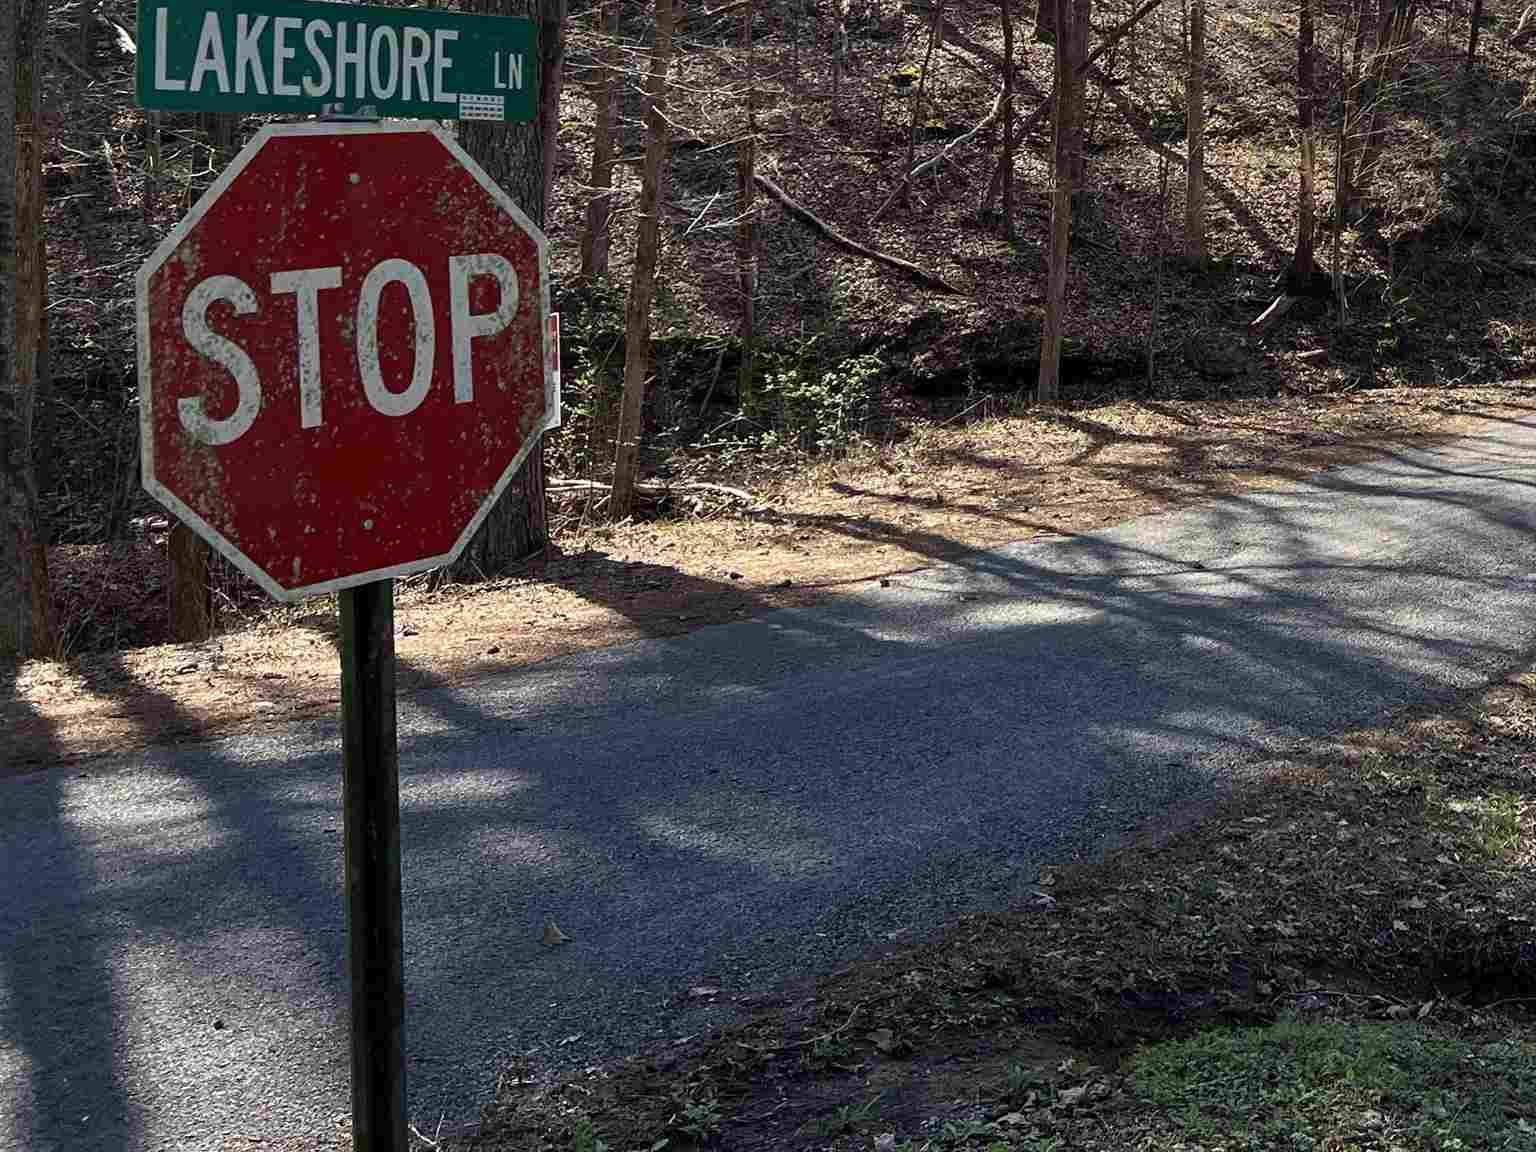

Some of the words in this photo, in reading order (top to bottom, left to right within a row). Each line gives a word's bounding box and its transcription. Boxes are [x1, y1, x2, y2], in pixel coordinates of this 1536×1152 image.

[154, 7, 459, 104] LAKESHORE
[494, 51, 522, 90] LN
[177, 253, 520, 446] STOP
